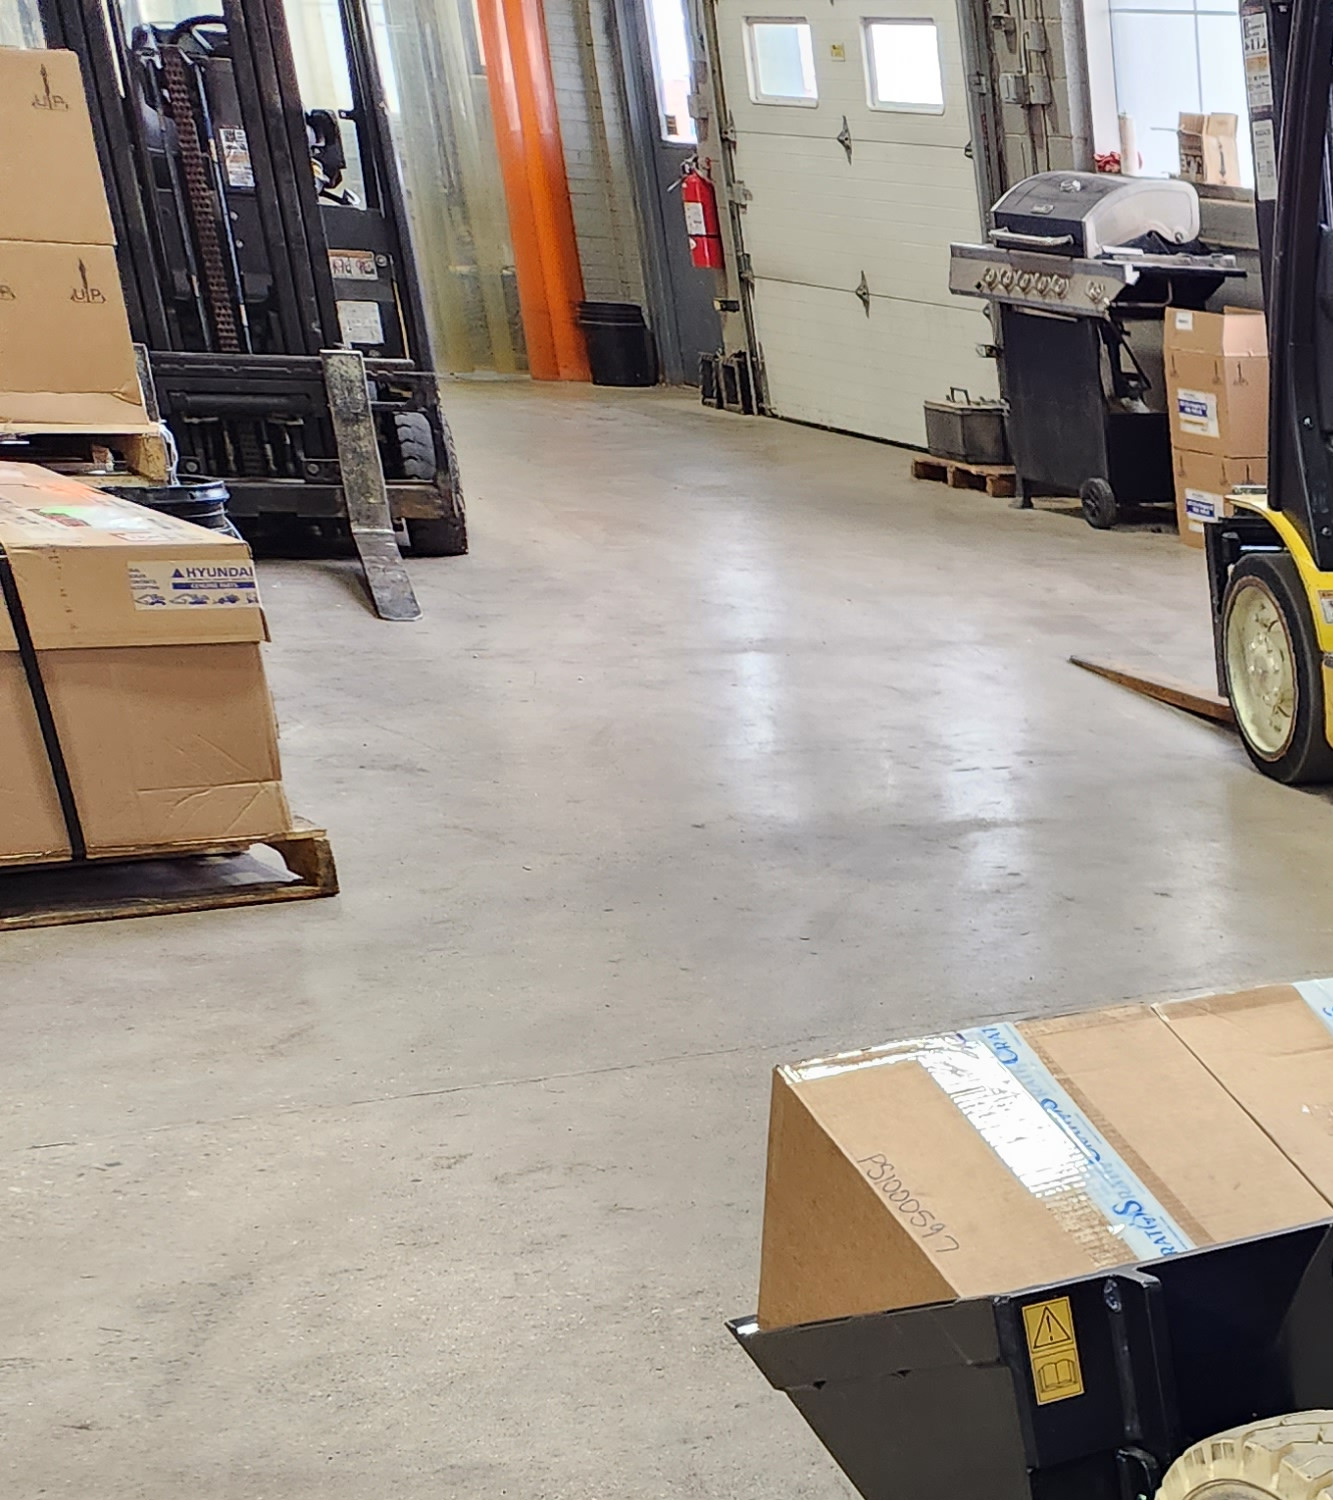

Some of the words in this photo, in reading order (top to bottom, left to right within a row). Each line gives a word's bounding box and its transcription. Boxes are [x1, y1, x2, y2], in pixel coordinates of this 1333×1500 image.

[72, 287, 104, 301] UP
[186, 567, 254, 578] HYUNDAI
[1113, 1200, 1179, 1257] RATOS
